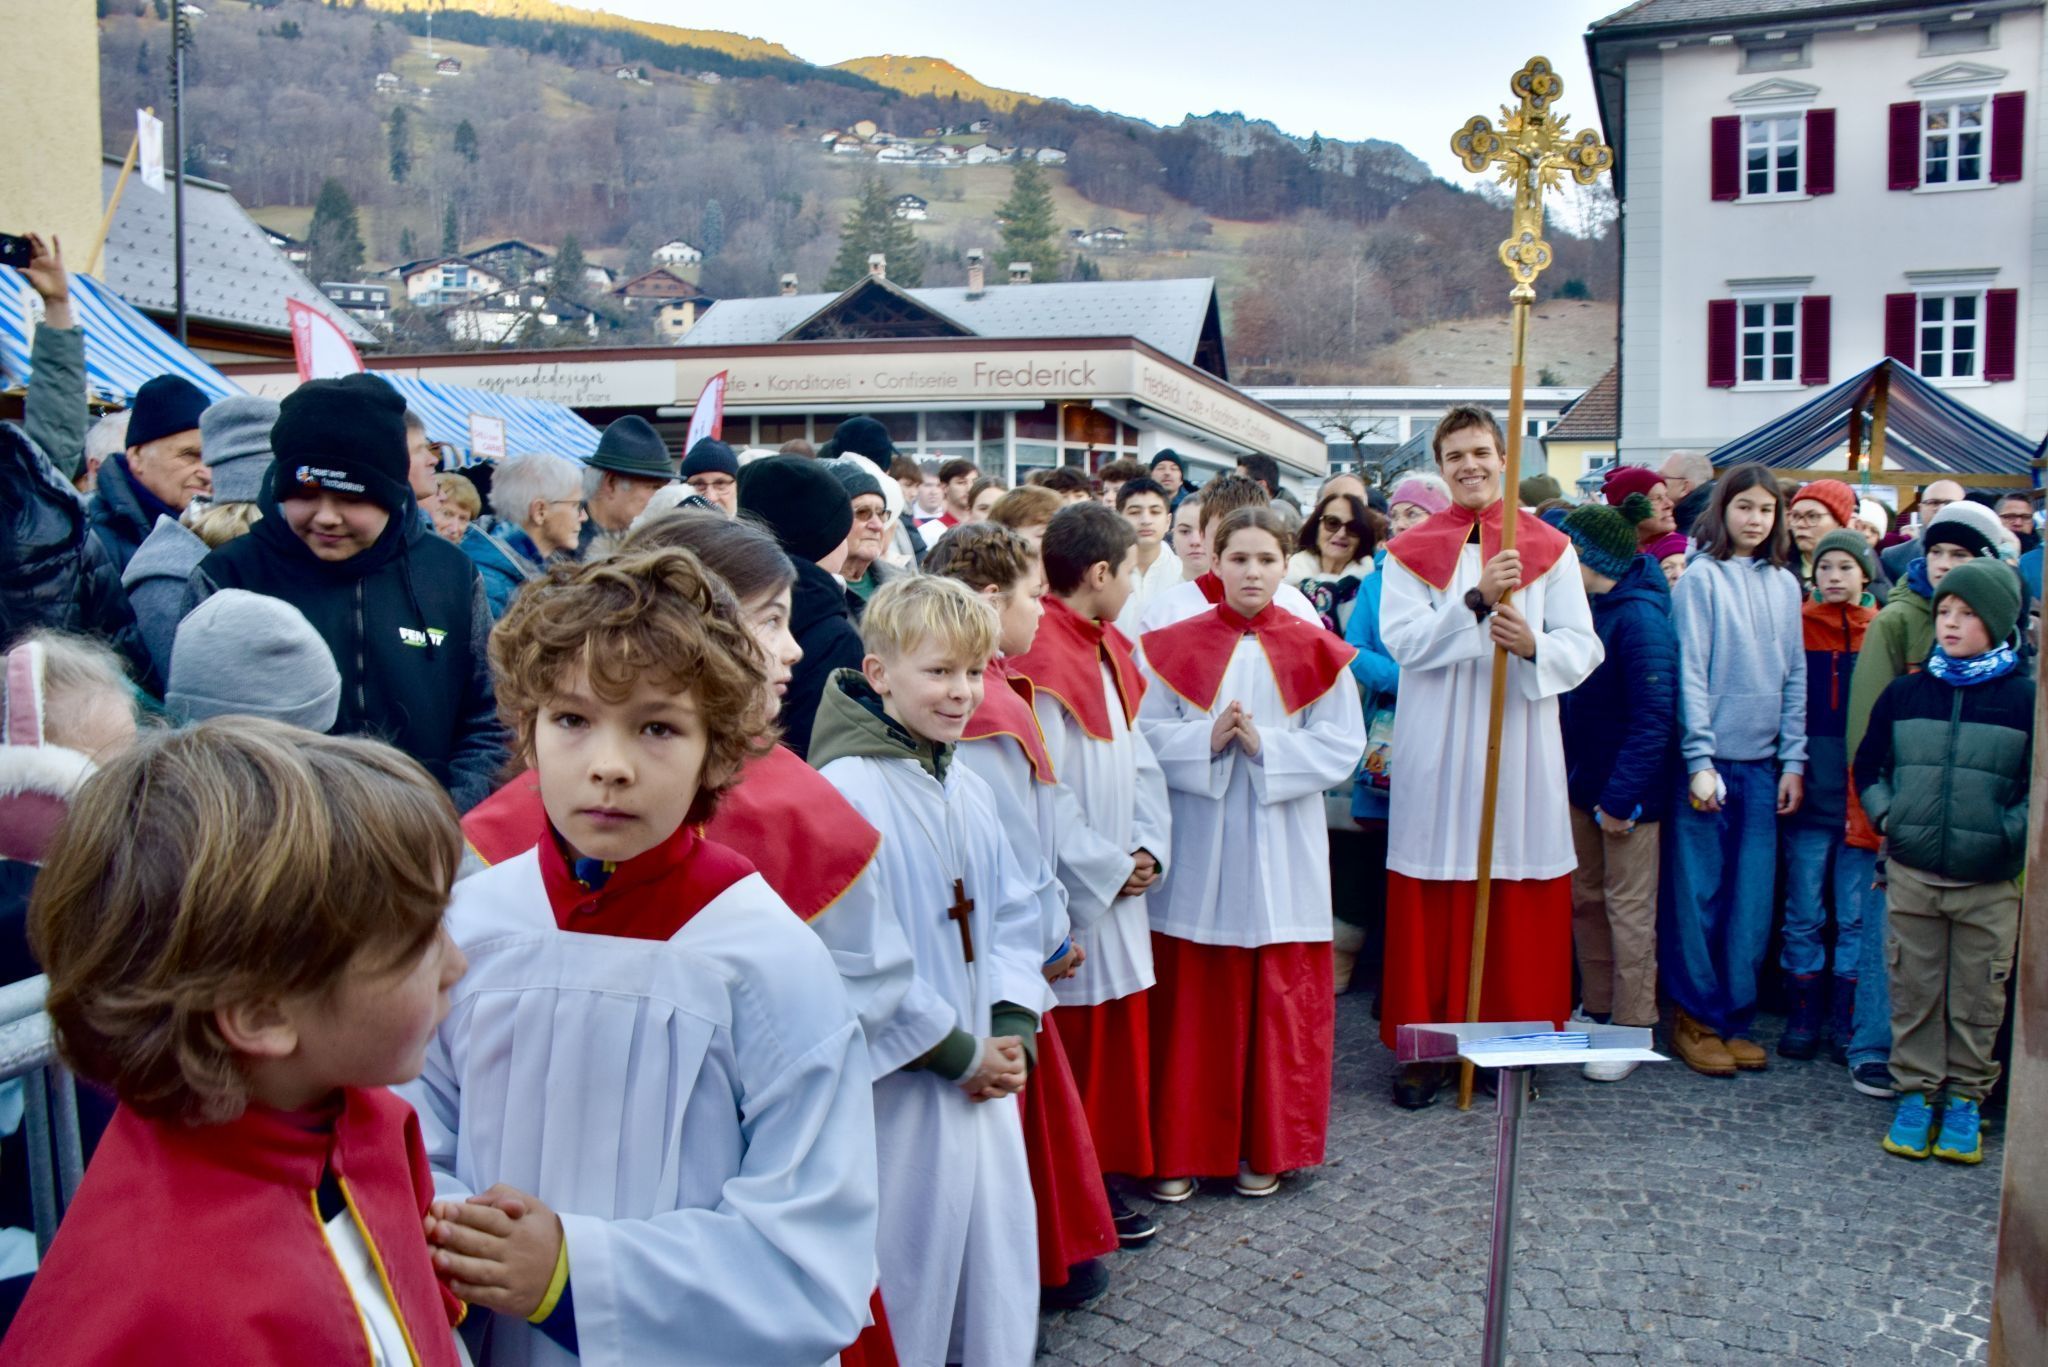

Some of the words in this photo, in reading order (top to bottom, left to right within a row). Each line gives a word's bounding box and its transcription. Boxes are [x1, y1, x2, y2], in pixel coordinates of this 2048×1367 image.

[767, 374, 850, 391] Konditorei
[874, 371, 958, 389] Confiserie
[973, 360, 1096, 387] Frederick
